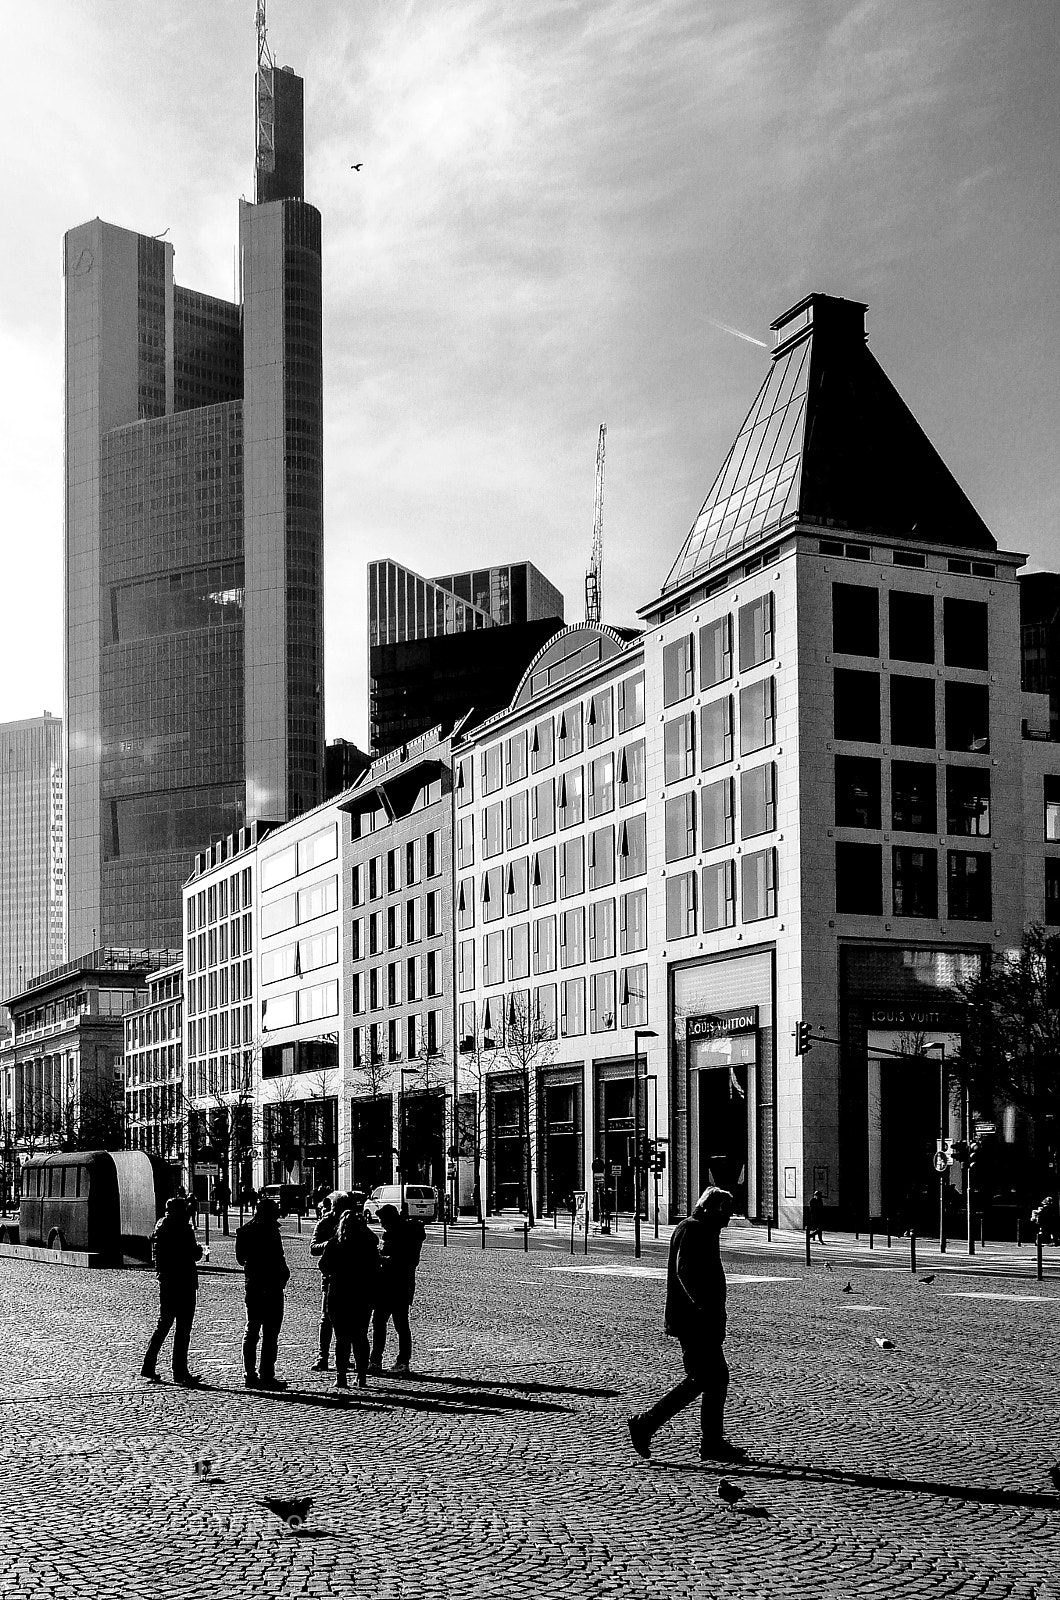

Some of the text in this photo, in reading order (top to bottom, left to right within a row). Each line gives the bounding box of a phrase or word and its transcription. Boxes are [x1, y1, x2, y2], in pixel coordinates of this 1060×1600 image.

[872, 1011, 905, 1023] LOUIS
[688, 1016, 753, 1035] LOUIS VUITTON
